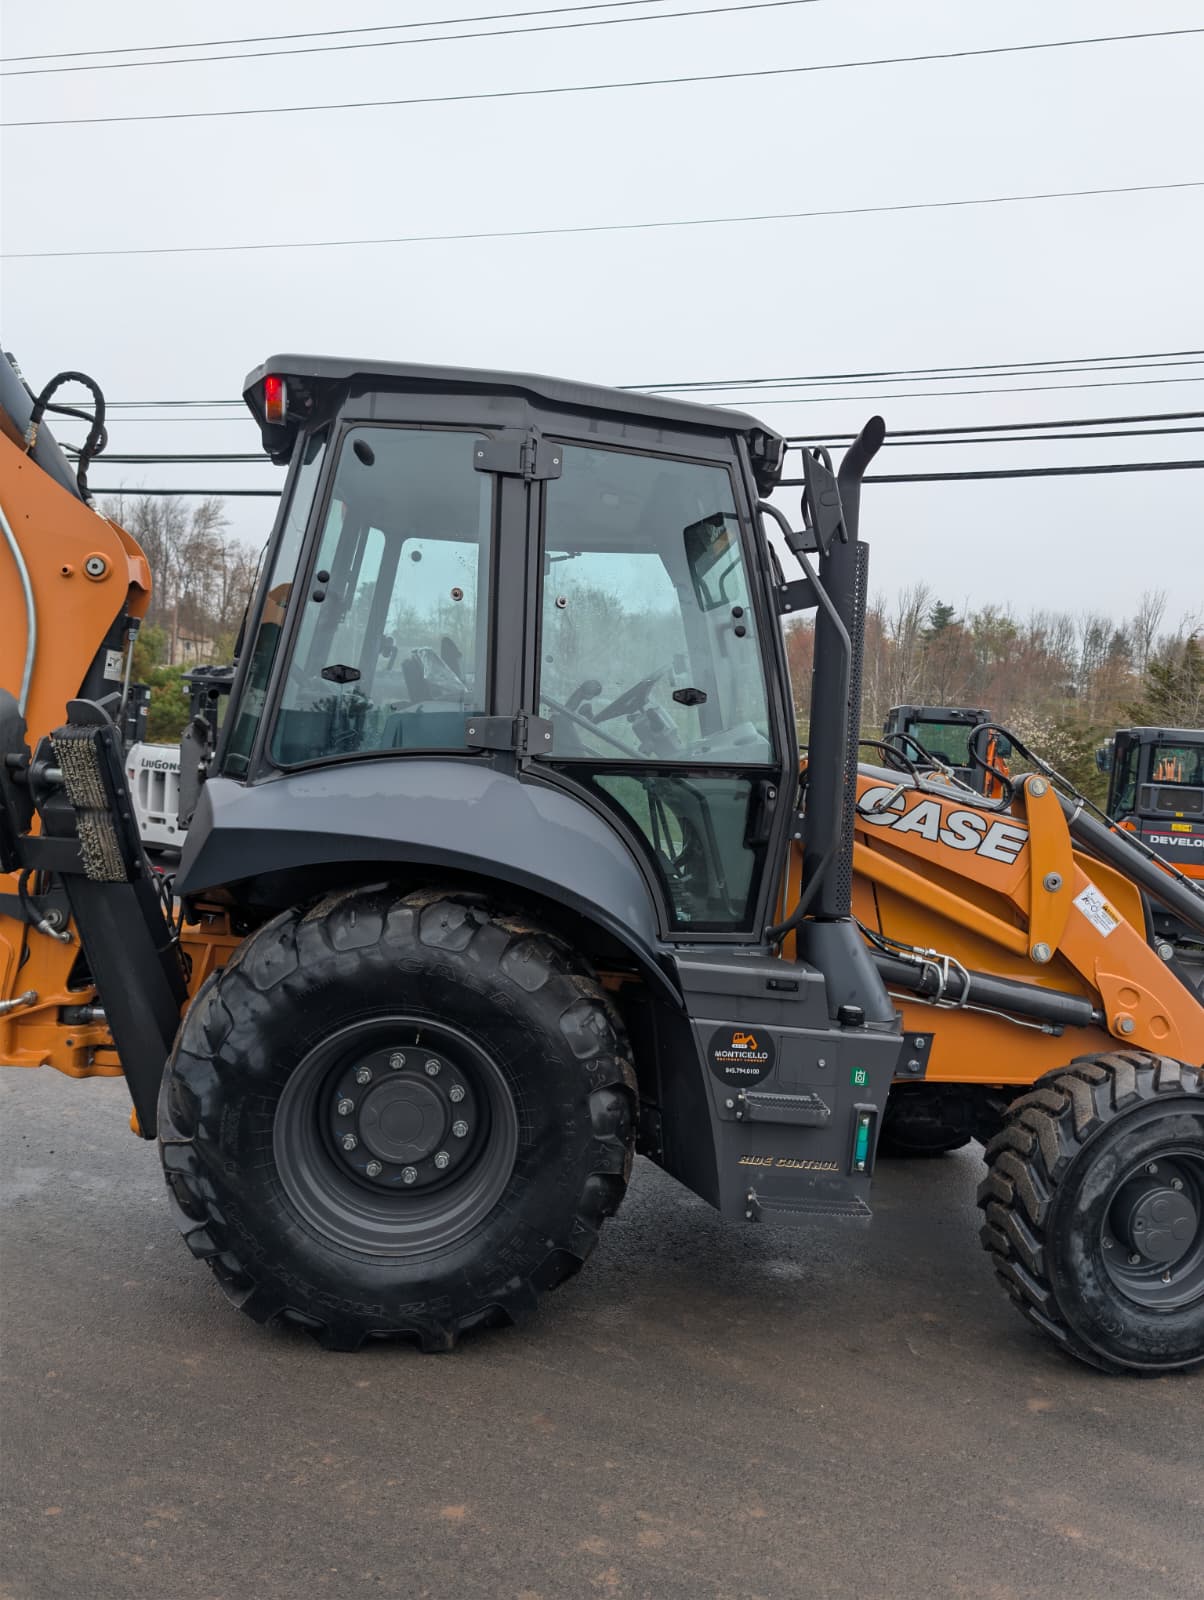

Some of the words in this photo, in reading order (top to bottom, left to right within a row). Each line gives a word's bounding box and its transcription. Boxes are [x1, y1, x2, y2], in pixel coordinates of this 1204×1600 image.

[857, 786, 1029, 865] CASE
[1150, 835, 1204, 847] DEVELO
[714, 1050, 768, 1059] MONTICELLO
[738, 1155, 773, 1166] RIDE
[776, 1157, 839, 1170] CONTROL
